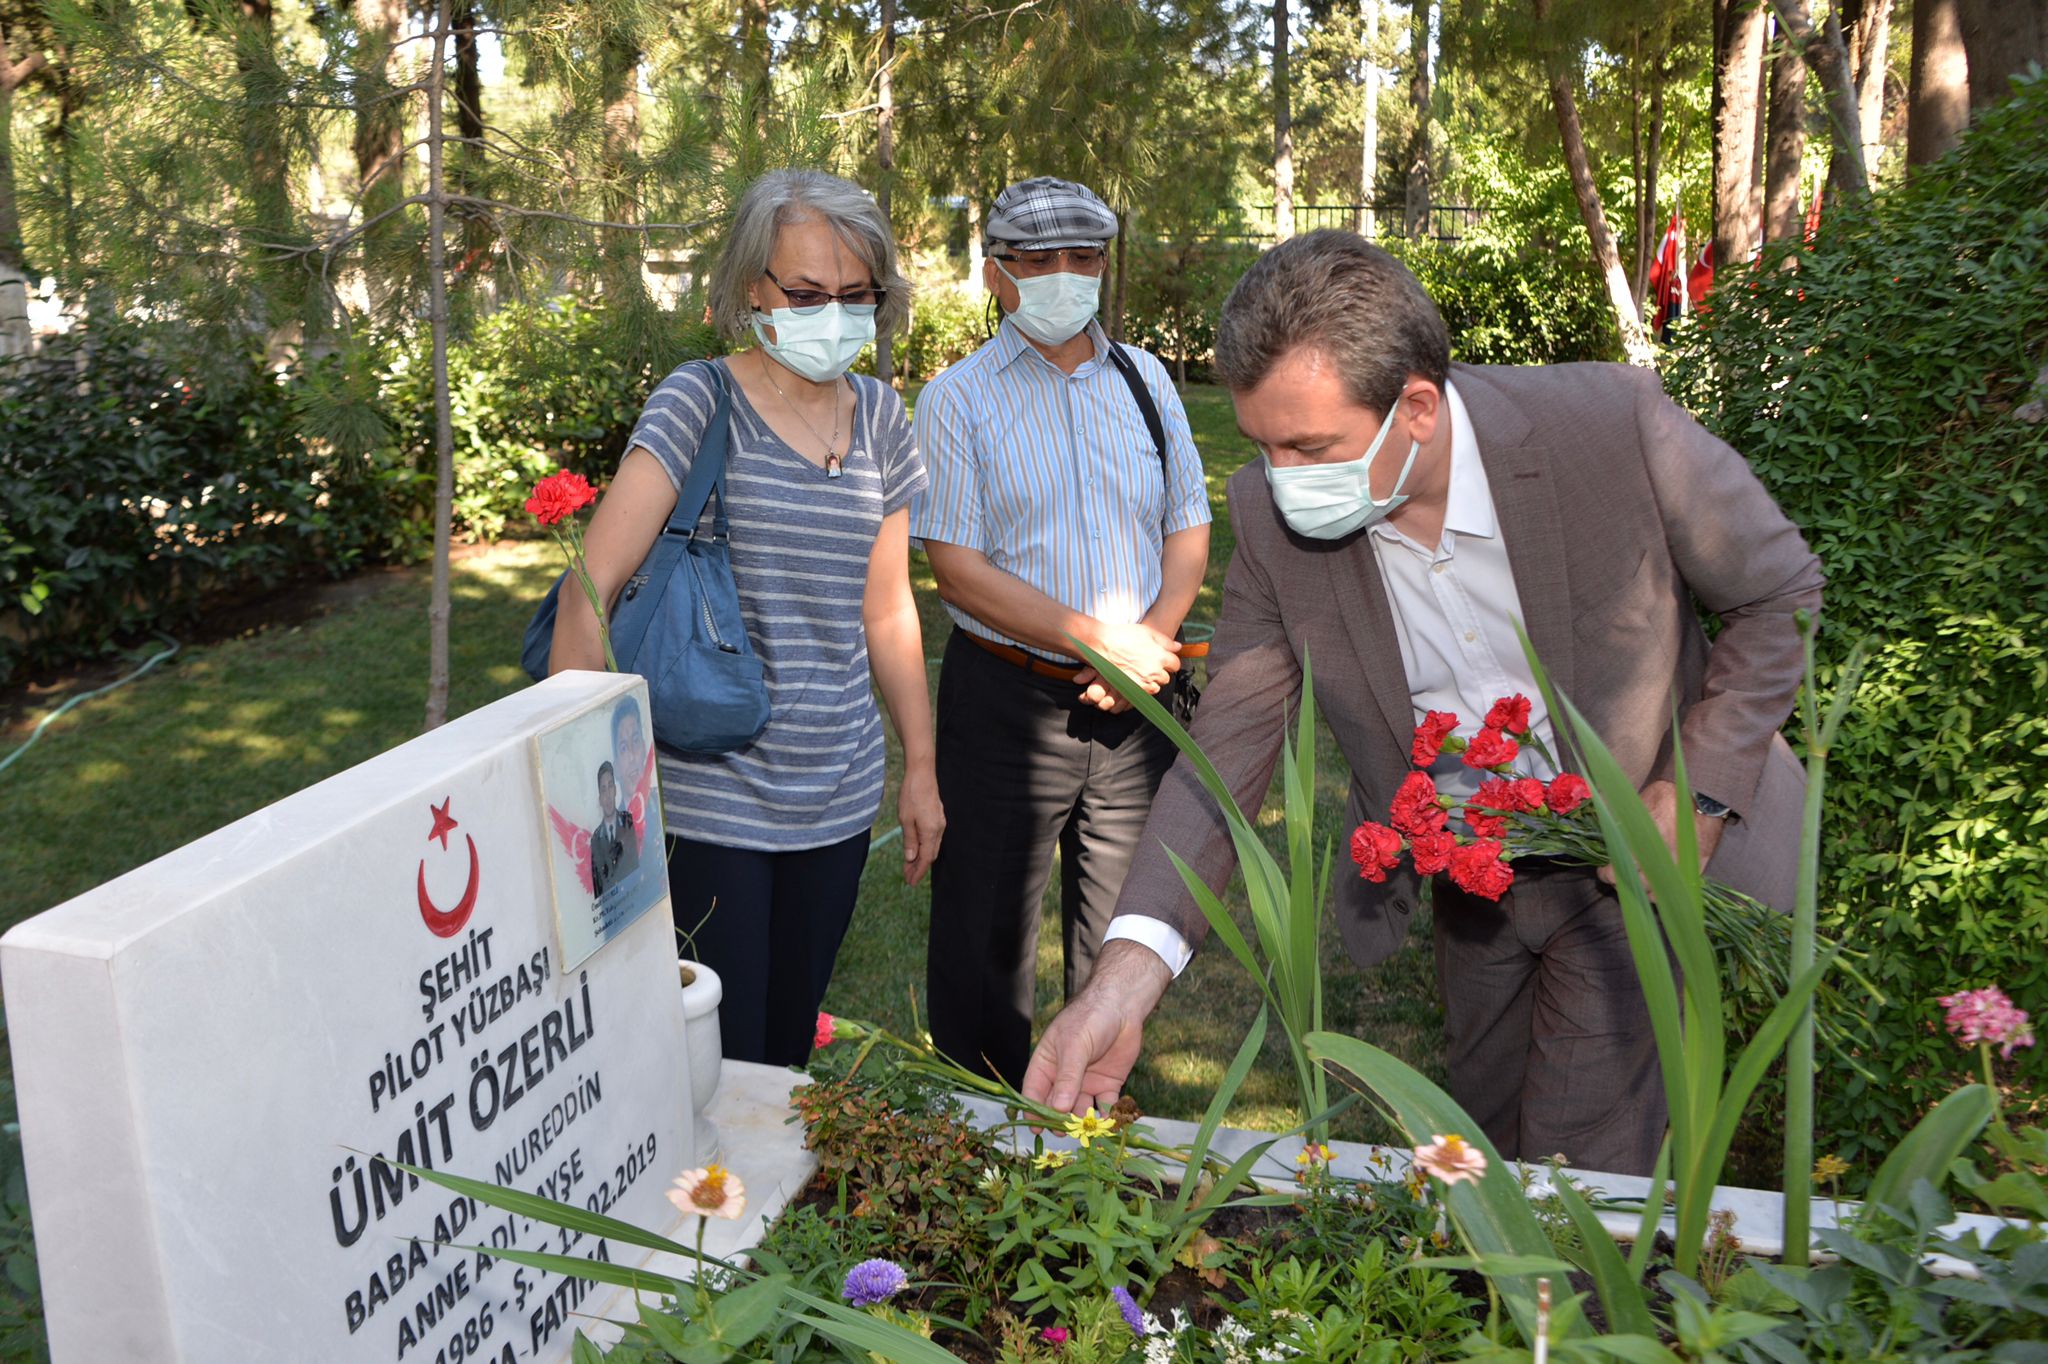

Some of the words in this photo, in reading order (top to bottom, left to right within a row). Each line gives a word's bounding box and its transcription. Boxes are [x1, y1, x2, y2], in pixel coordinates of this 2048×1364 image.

[368, 1023, 446, 1114] PİLOT
[451, 946, 551, 1047] YÜZBAŞI
[419, 927, 494, 1024] ŞEHİT
[329, 1092, 456, 1249] ÜMİT
[468, 970, 595, 1132] ÖZERLİ
[344, 1235, 429, 1336] BABA
[433, 1196, 477, 1258] ADI
[494, 1071, 602, 1187] NUREDDİN
[397, 1259, 470, 1362] ANNE
